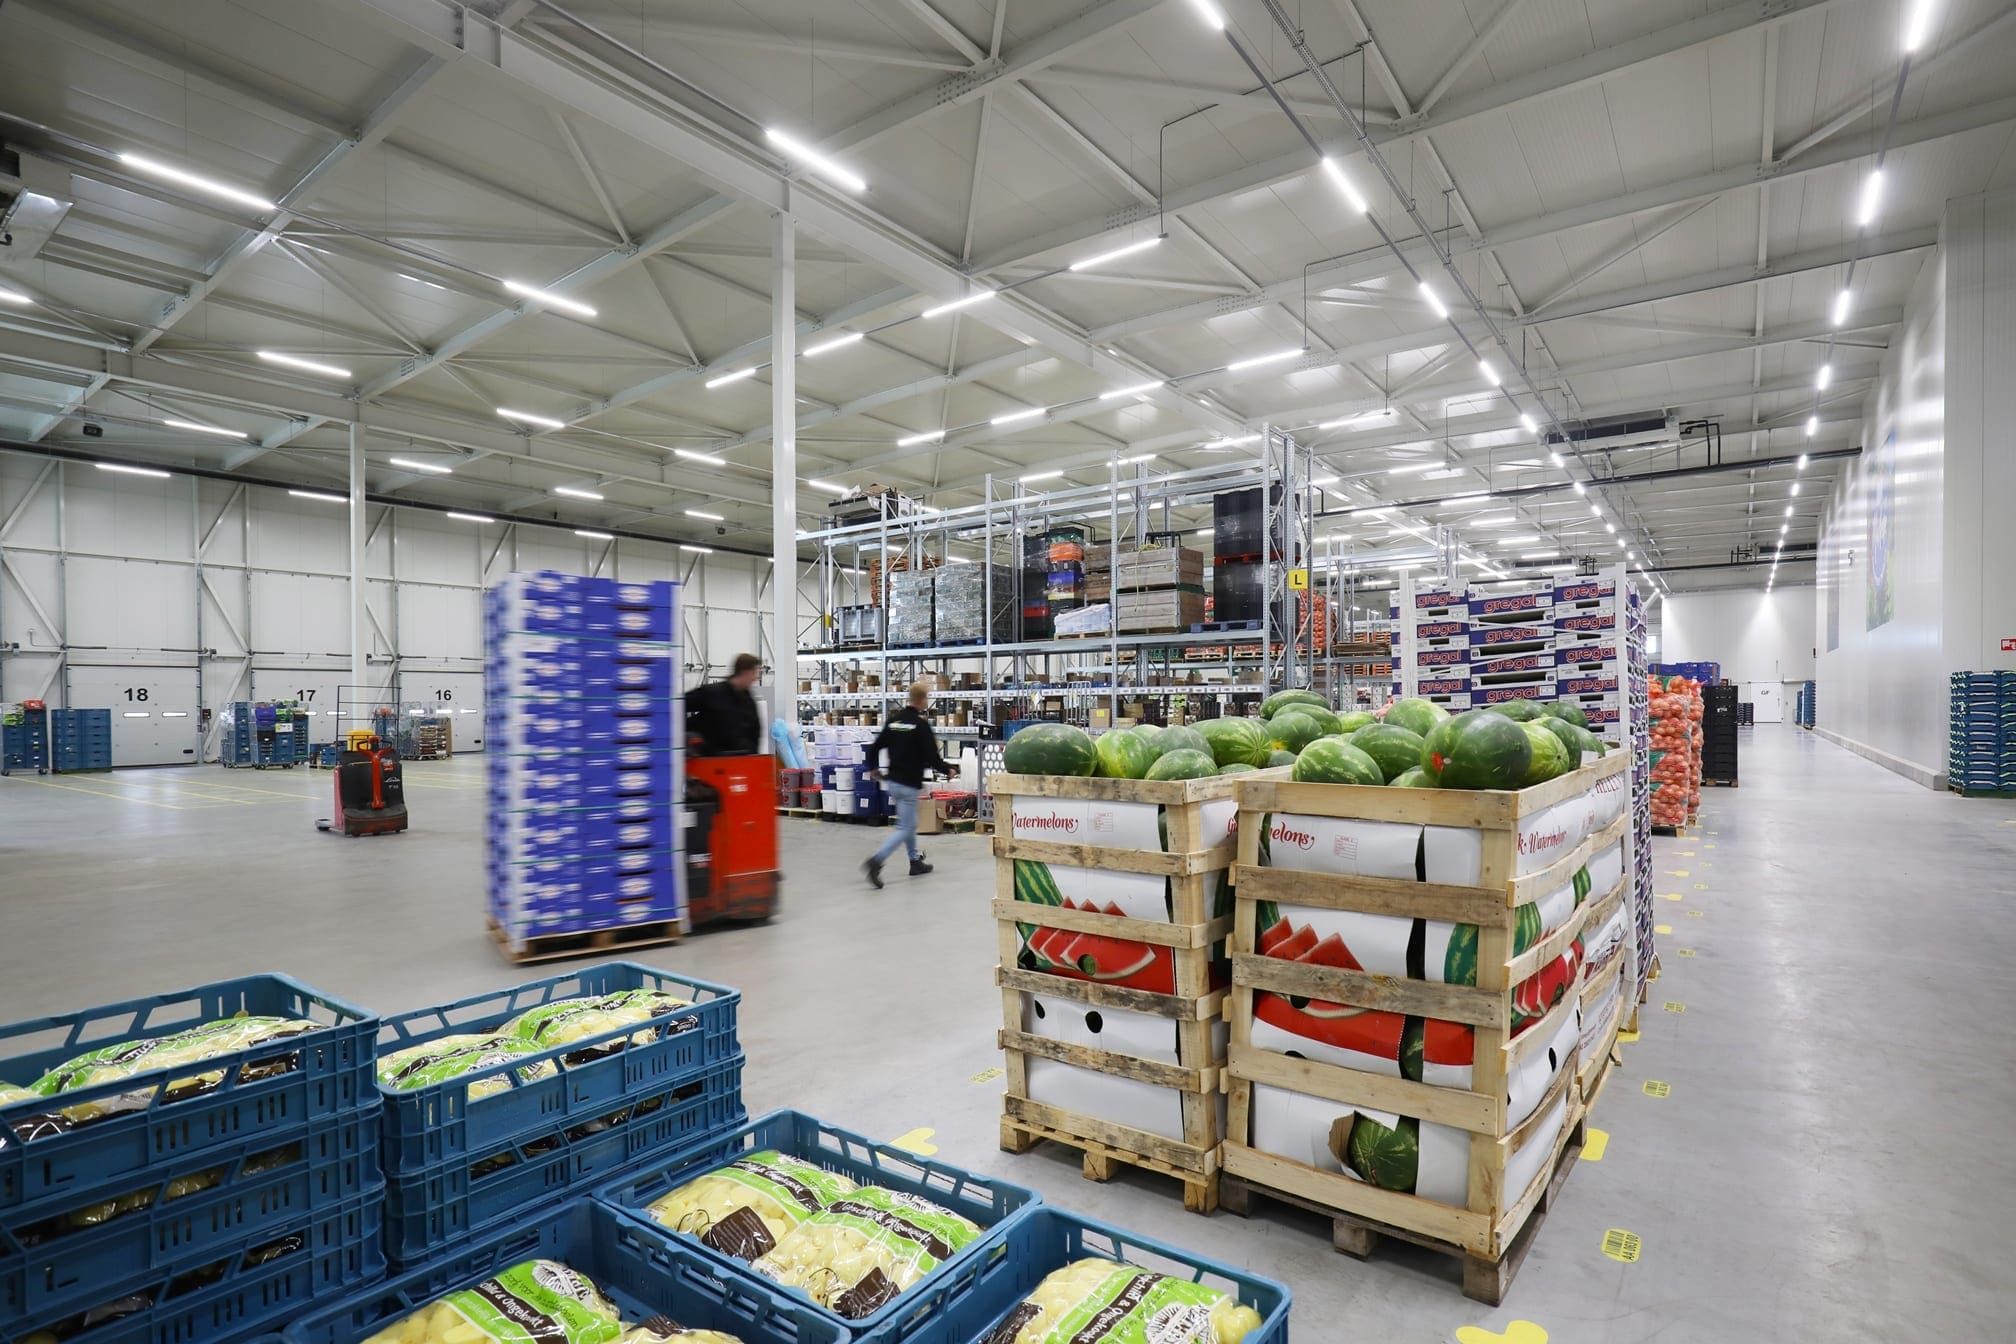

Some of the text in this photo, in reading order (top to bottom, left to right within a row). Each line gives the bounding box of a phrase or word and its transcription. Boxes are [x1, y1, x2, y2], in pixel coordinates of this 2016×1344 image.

[1295, 574, 1302, 585] L
[1484, 594, 1536, 613] gregal
[1418, 622, 1461, 638] gregal
[1564, 615, 1614, 630] gregal
[1485, 628, 1538, 643] gregal
[1418, 651, 1461, 665] gregal
[1566, 647, 1616, 663] gregal
[1487, 656, 1538, 673] gregal
[1419, 680, 1463, 694] gregal
[1486, 685, 1539, 703] gregal
[1567, 679, 1618, 694] gregal
[124, 687, 149, 702] 18
[297, 689, 317, 702] 17
[435, 689, 452, 701] 16
